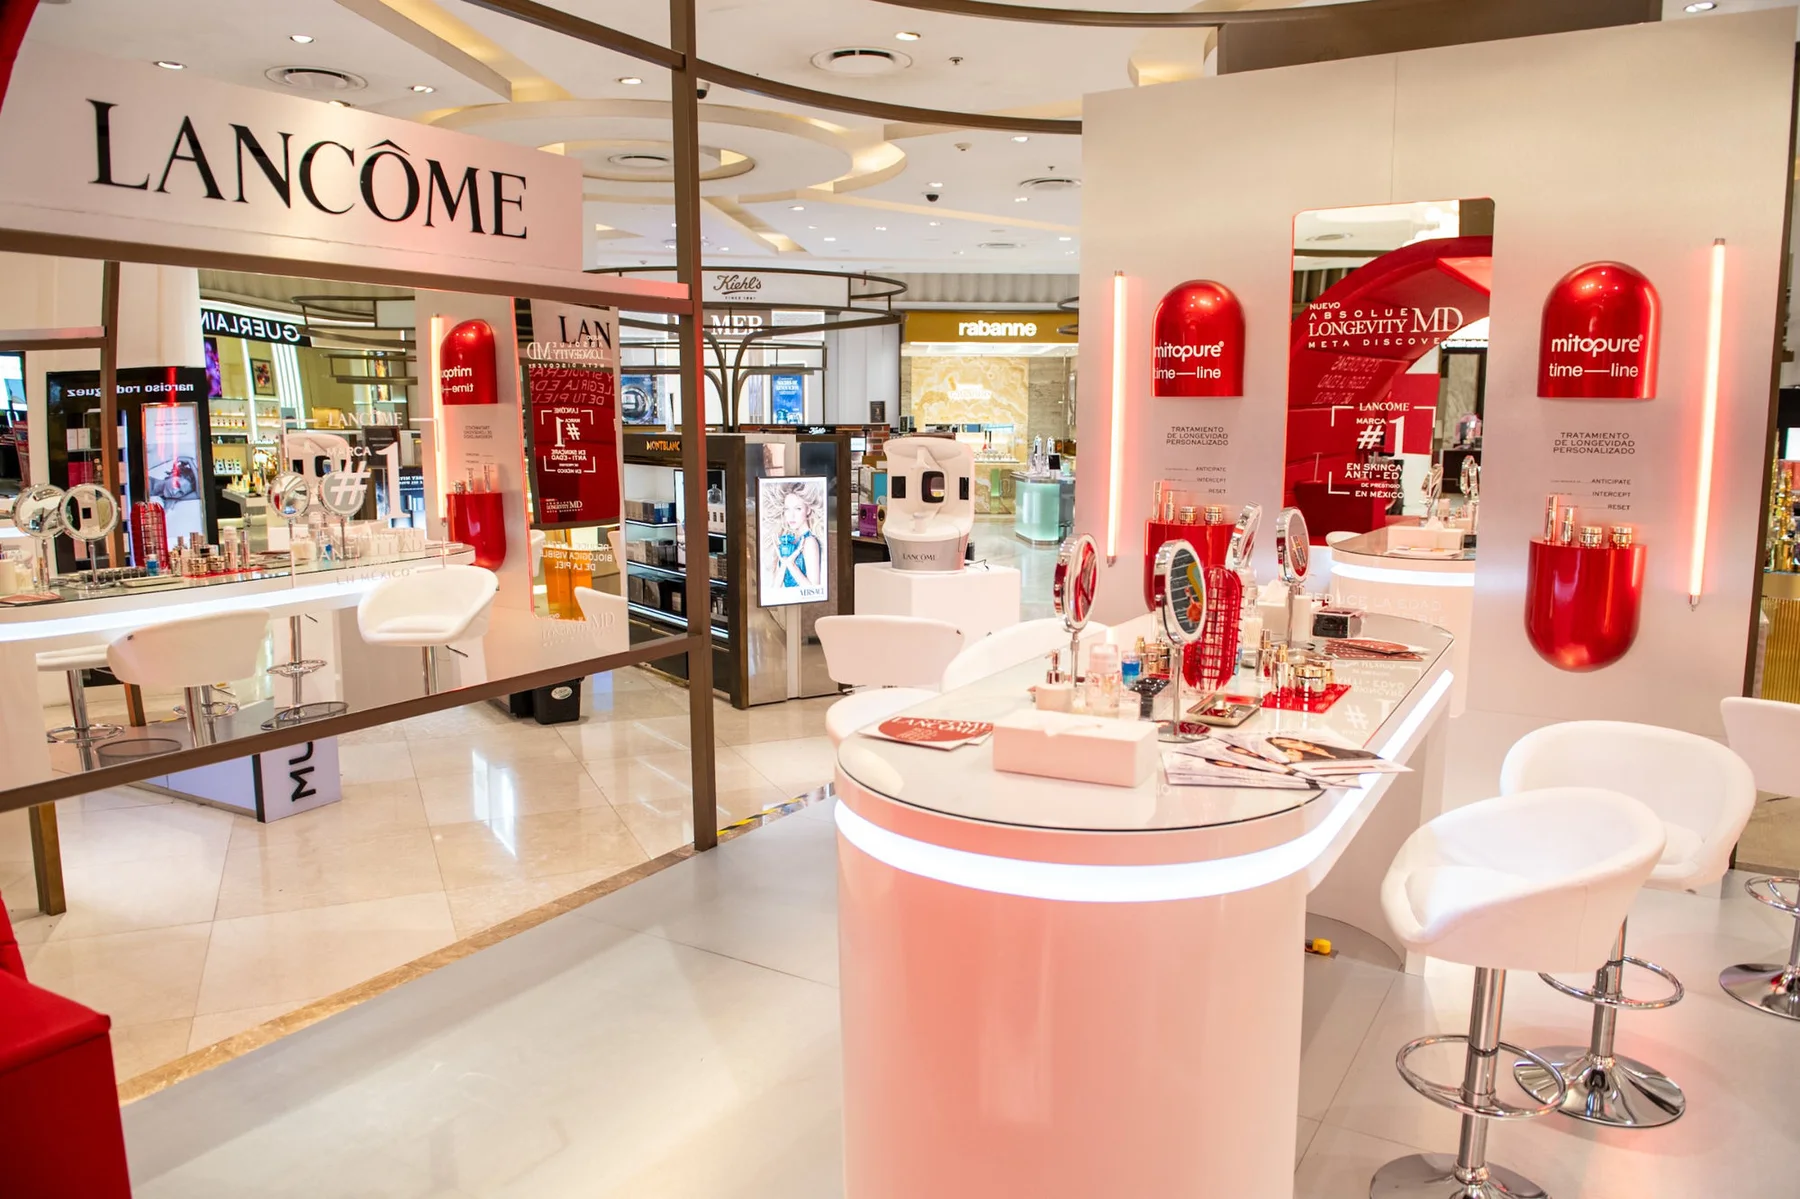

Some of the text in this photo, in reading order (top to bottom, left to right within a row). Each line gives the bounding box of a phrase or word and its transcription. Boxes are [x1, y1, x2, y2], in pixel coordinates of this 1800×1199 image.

[86, 98, 527, 239] LANCÔME
[713, 274, 762, 291] Kiehl's
[1309, 302, 1340, 311] NUEVO
[1309, 306, 1464, 333] ABSOLUE MD
[958, 320, 1037, 337] rabanne
[1309, 319, 1408, 337] LONGEVITY
[1308, 340, 1350, 349] META
[1359, 401, 1410, 411] LANCÔME
[1553, 447, 1636, 455] PERSONALIZADO
[1346, 463, 1361, 471] EN
[1355, 490, 1404, 499] EN MÉXICO
